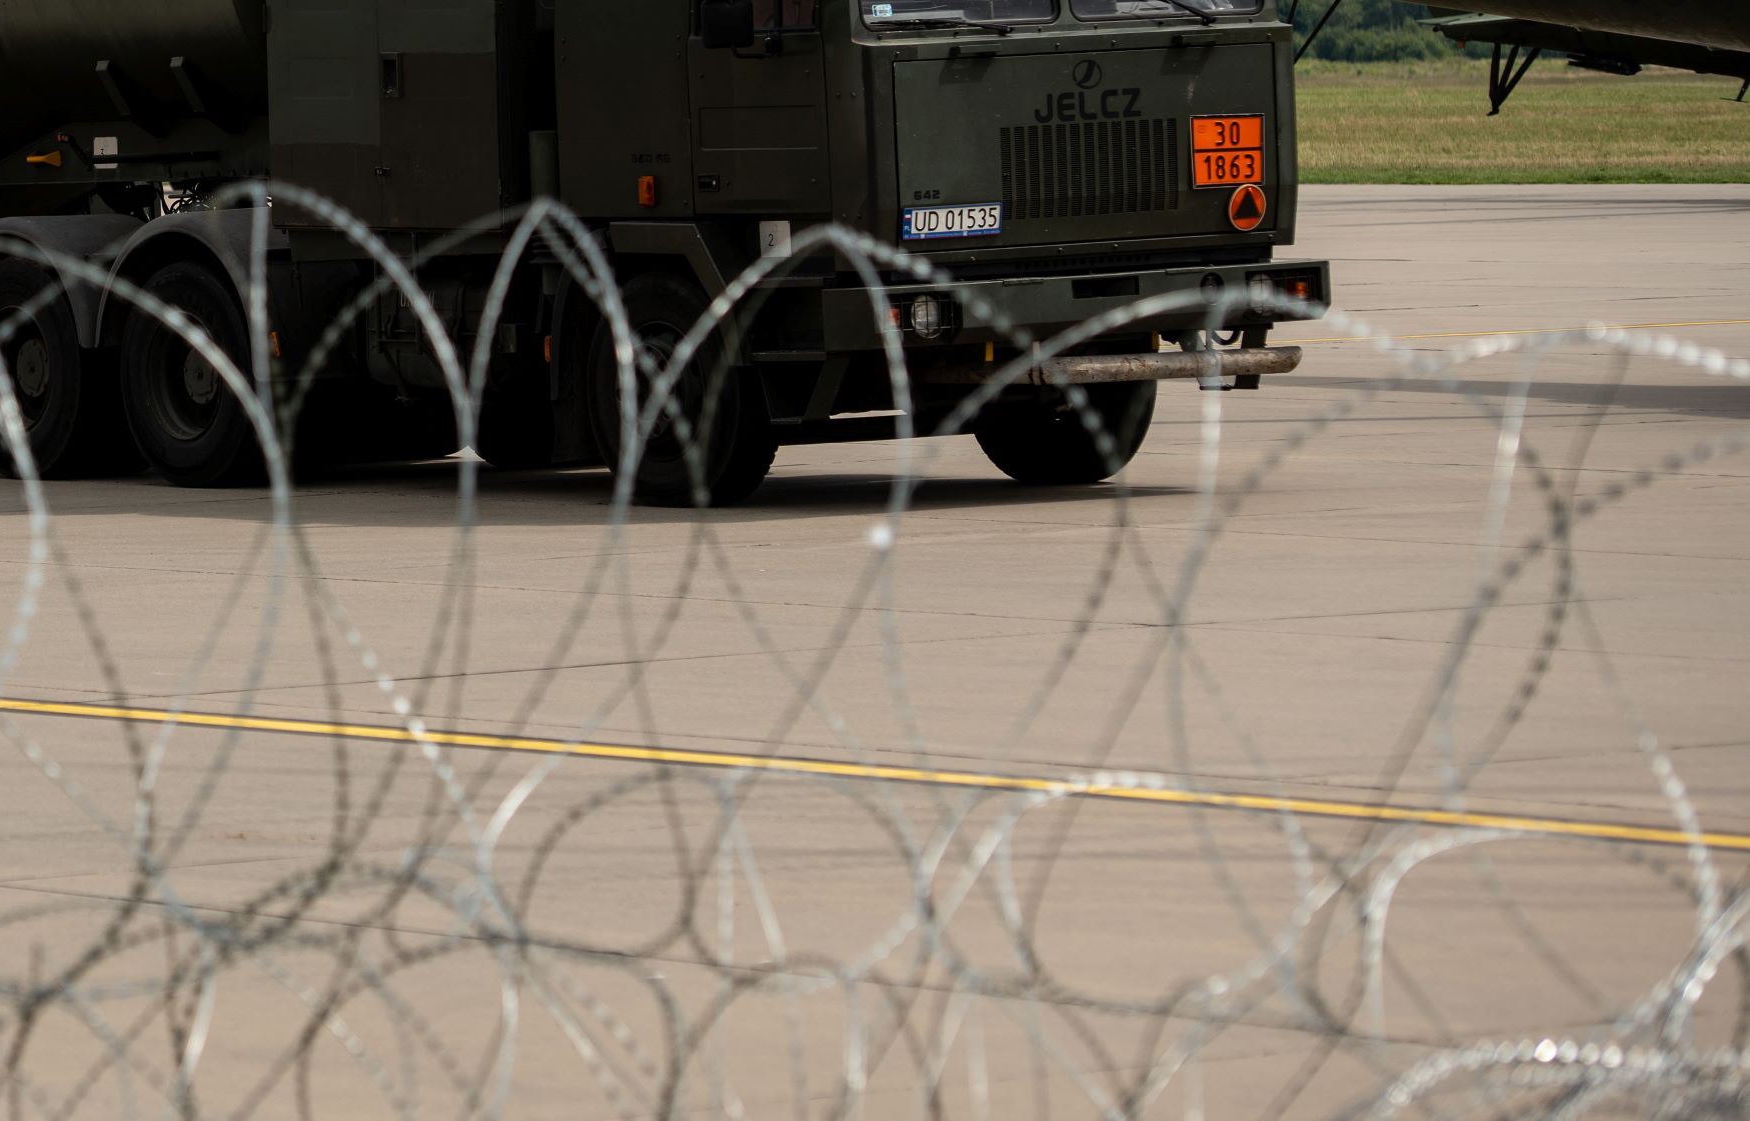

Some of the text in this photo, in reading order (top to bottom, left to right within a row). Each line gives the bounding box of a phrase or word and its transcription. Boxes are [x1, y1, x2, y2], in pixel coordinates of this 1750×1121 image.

[1034, 88, 1142, 123] JELCZ
[1214, 121, 1240, 146] 30
[1204, 154, 1255, 179] 1863
[914, 207, 998, 232] UD 01535
[768, 233, 774, 247] 2
